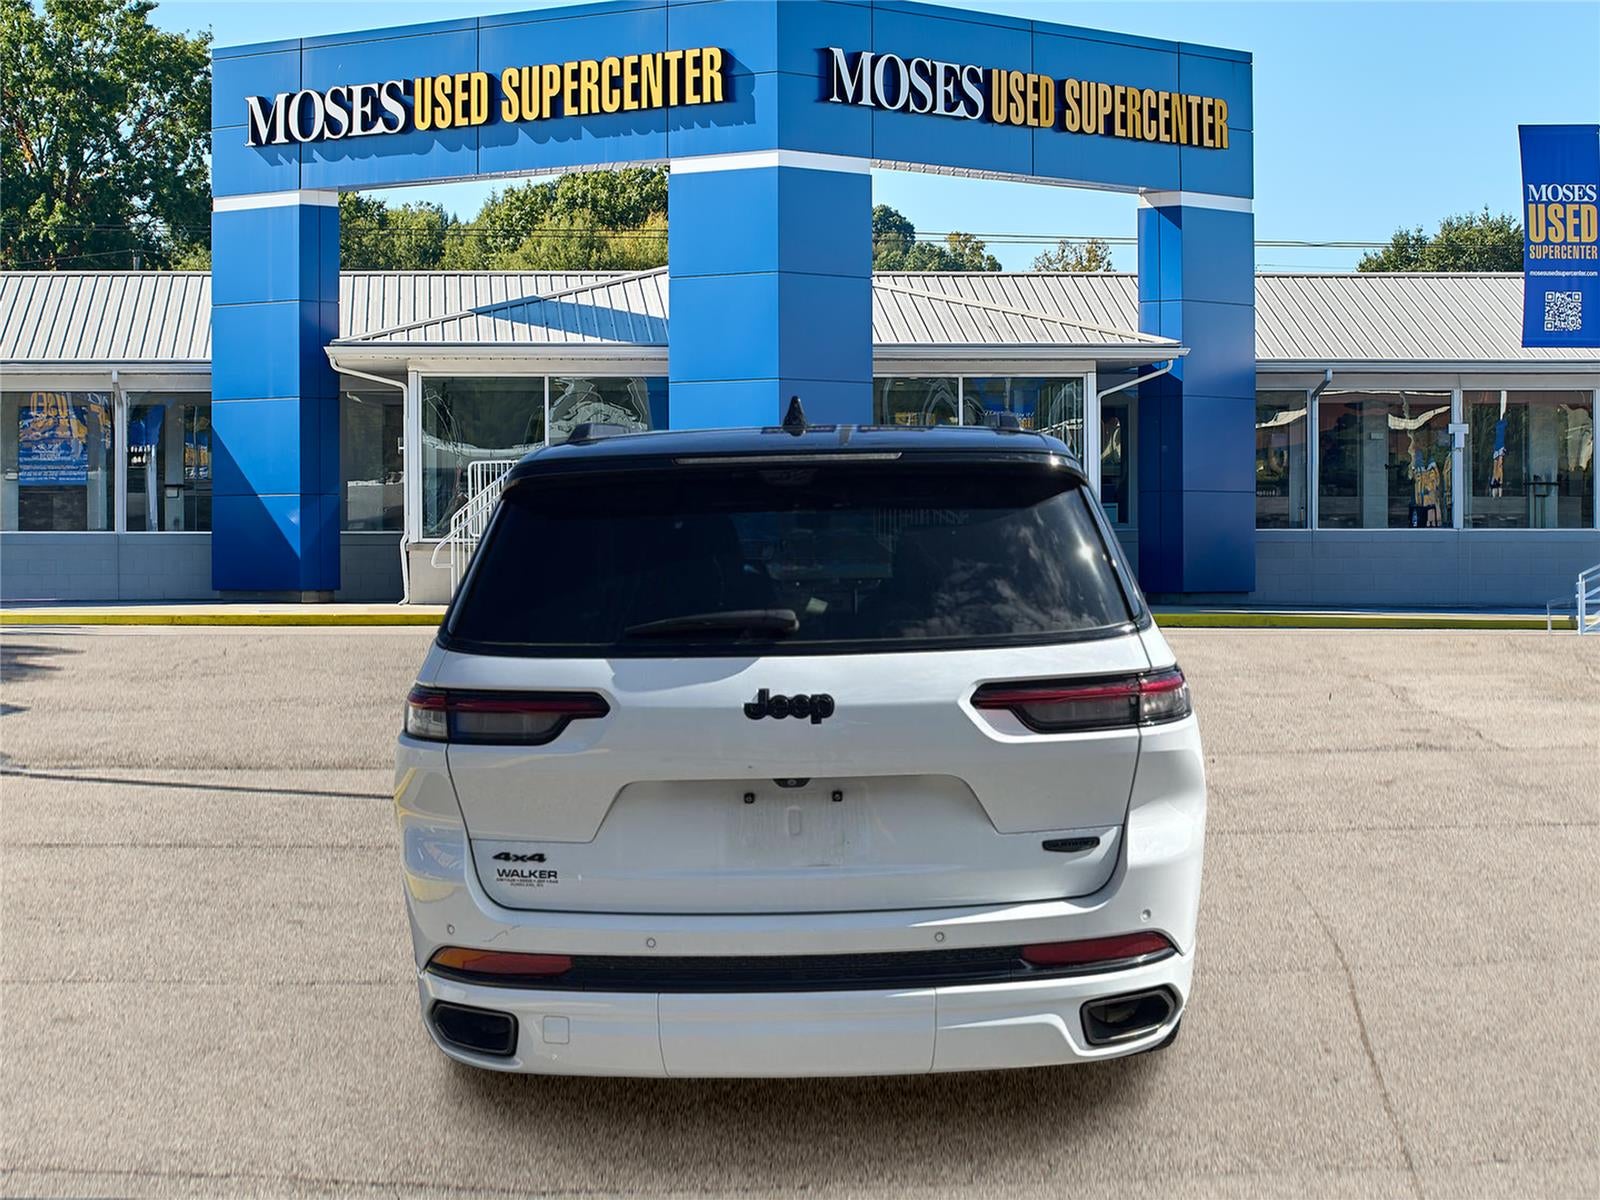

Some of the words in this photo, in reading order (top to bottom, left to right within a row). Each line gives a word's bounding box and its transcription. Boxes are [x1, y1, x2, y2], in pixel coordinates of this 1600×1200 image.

[244, 80, 407, 147] MOSES
[413, 71, 489, 131] USED
[500, 46, 724, 123] SUPERCENTER
[828, 46, 985, 120] MOSES
[991, 68, 1055, 128] USED
[1064, 78, 1230, 149] SUPERCENTER
[1527, 184, 1598, 202] MOSES
[1528, 204, 1599, 243] USED
[1529, 245, 1598, 259] SUPERCENTER
[743, 688, 835, 724] Jeep
[492, 852, 547, 862] 4x4
[496, 868, 558, 879] WALKER
